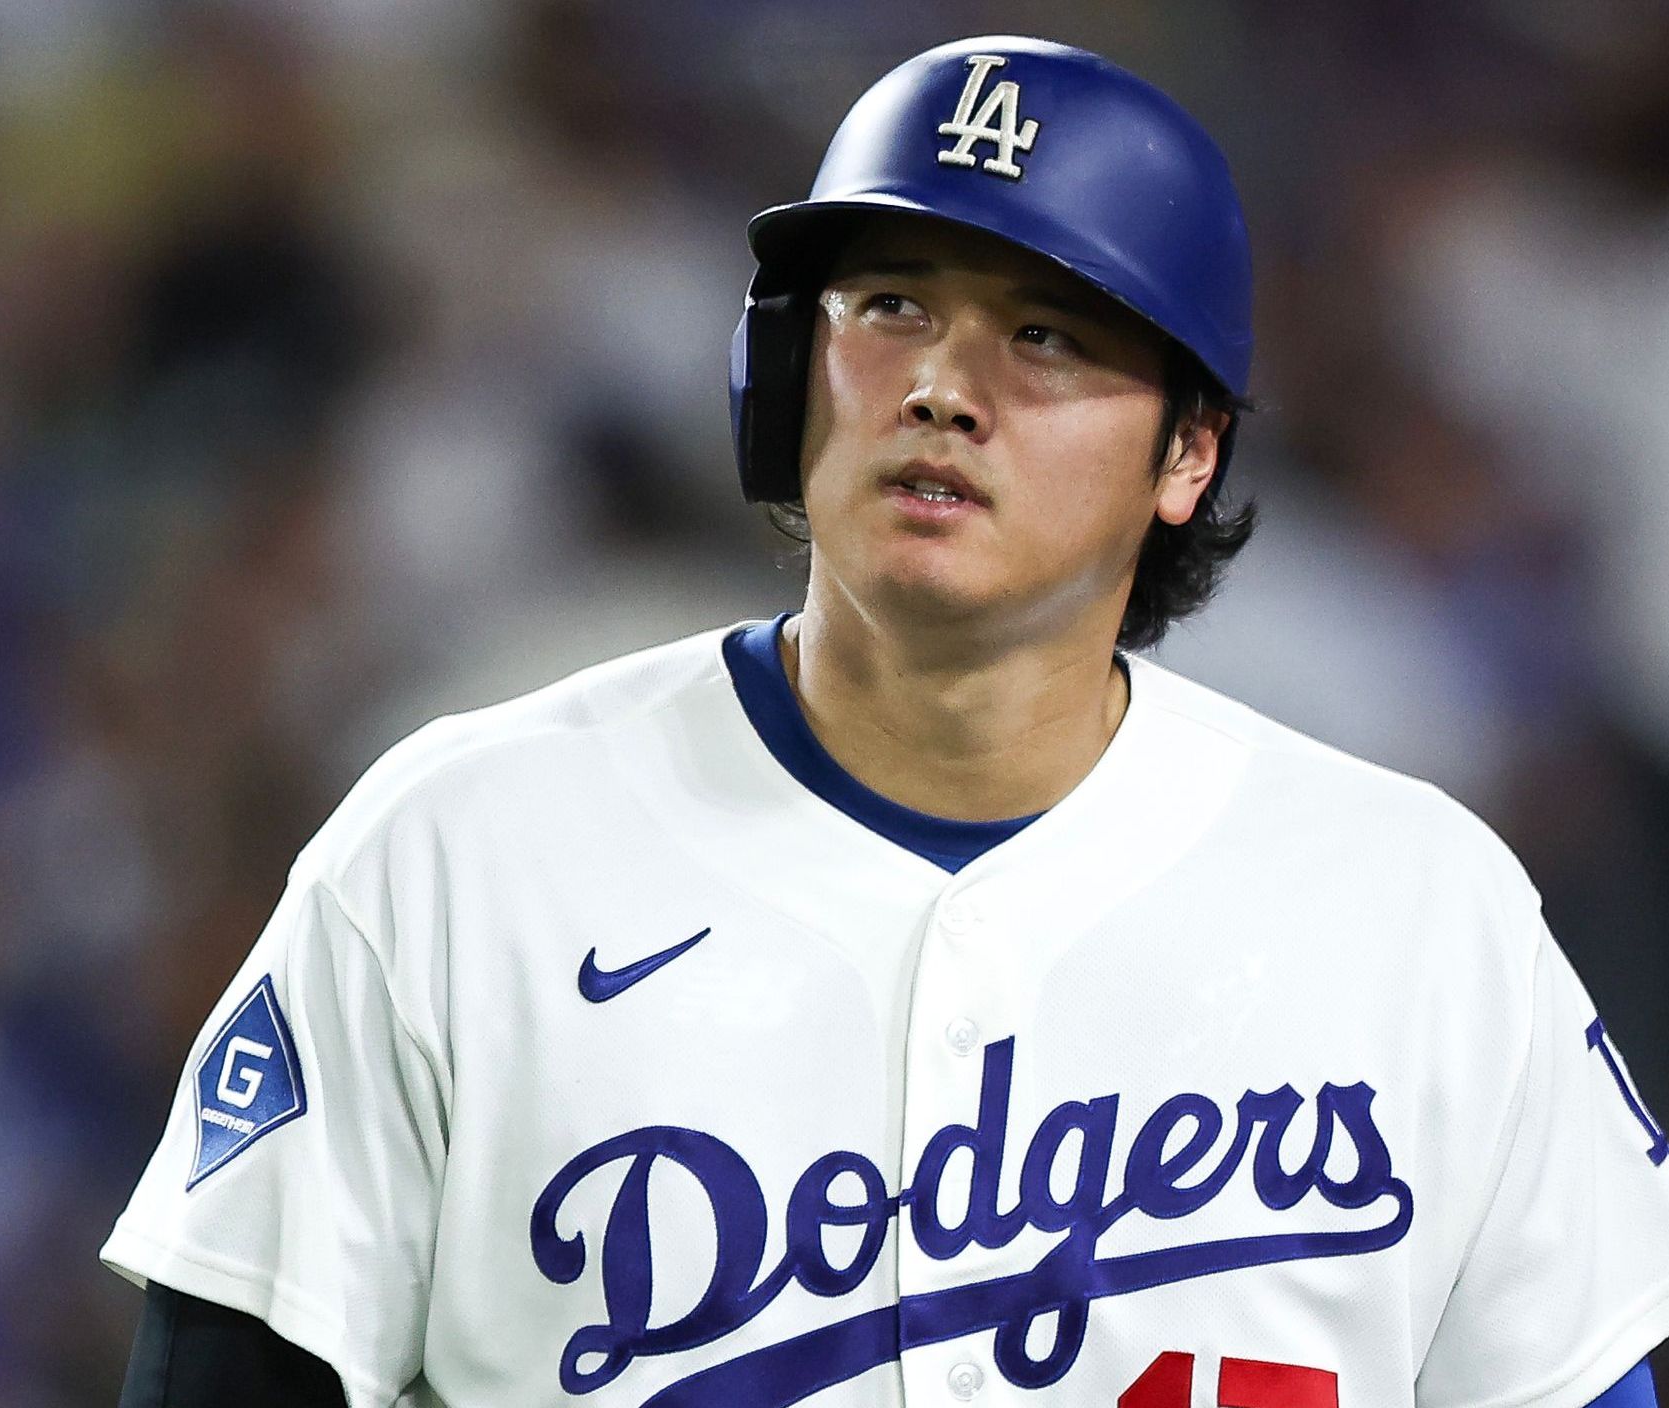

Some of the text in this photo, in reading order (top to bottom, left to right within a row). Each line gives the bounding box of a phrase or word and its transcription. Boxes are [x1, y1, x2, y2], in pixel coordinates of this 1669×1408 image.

[938, 55, 1039, 178] LA
[216, 1035, 273, 1110] G
[530, 1035, 1414, 1392] Dodgers
